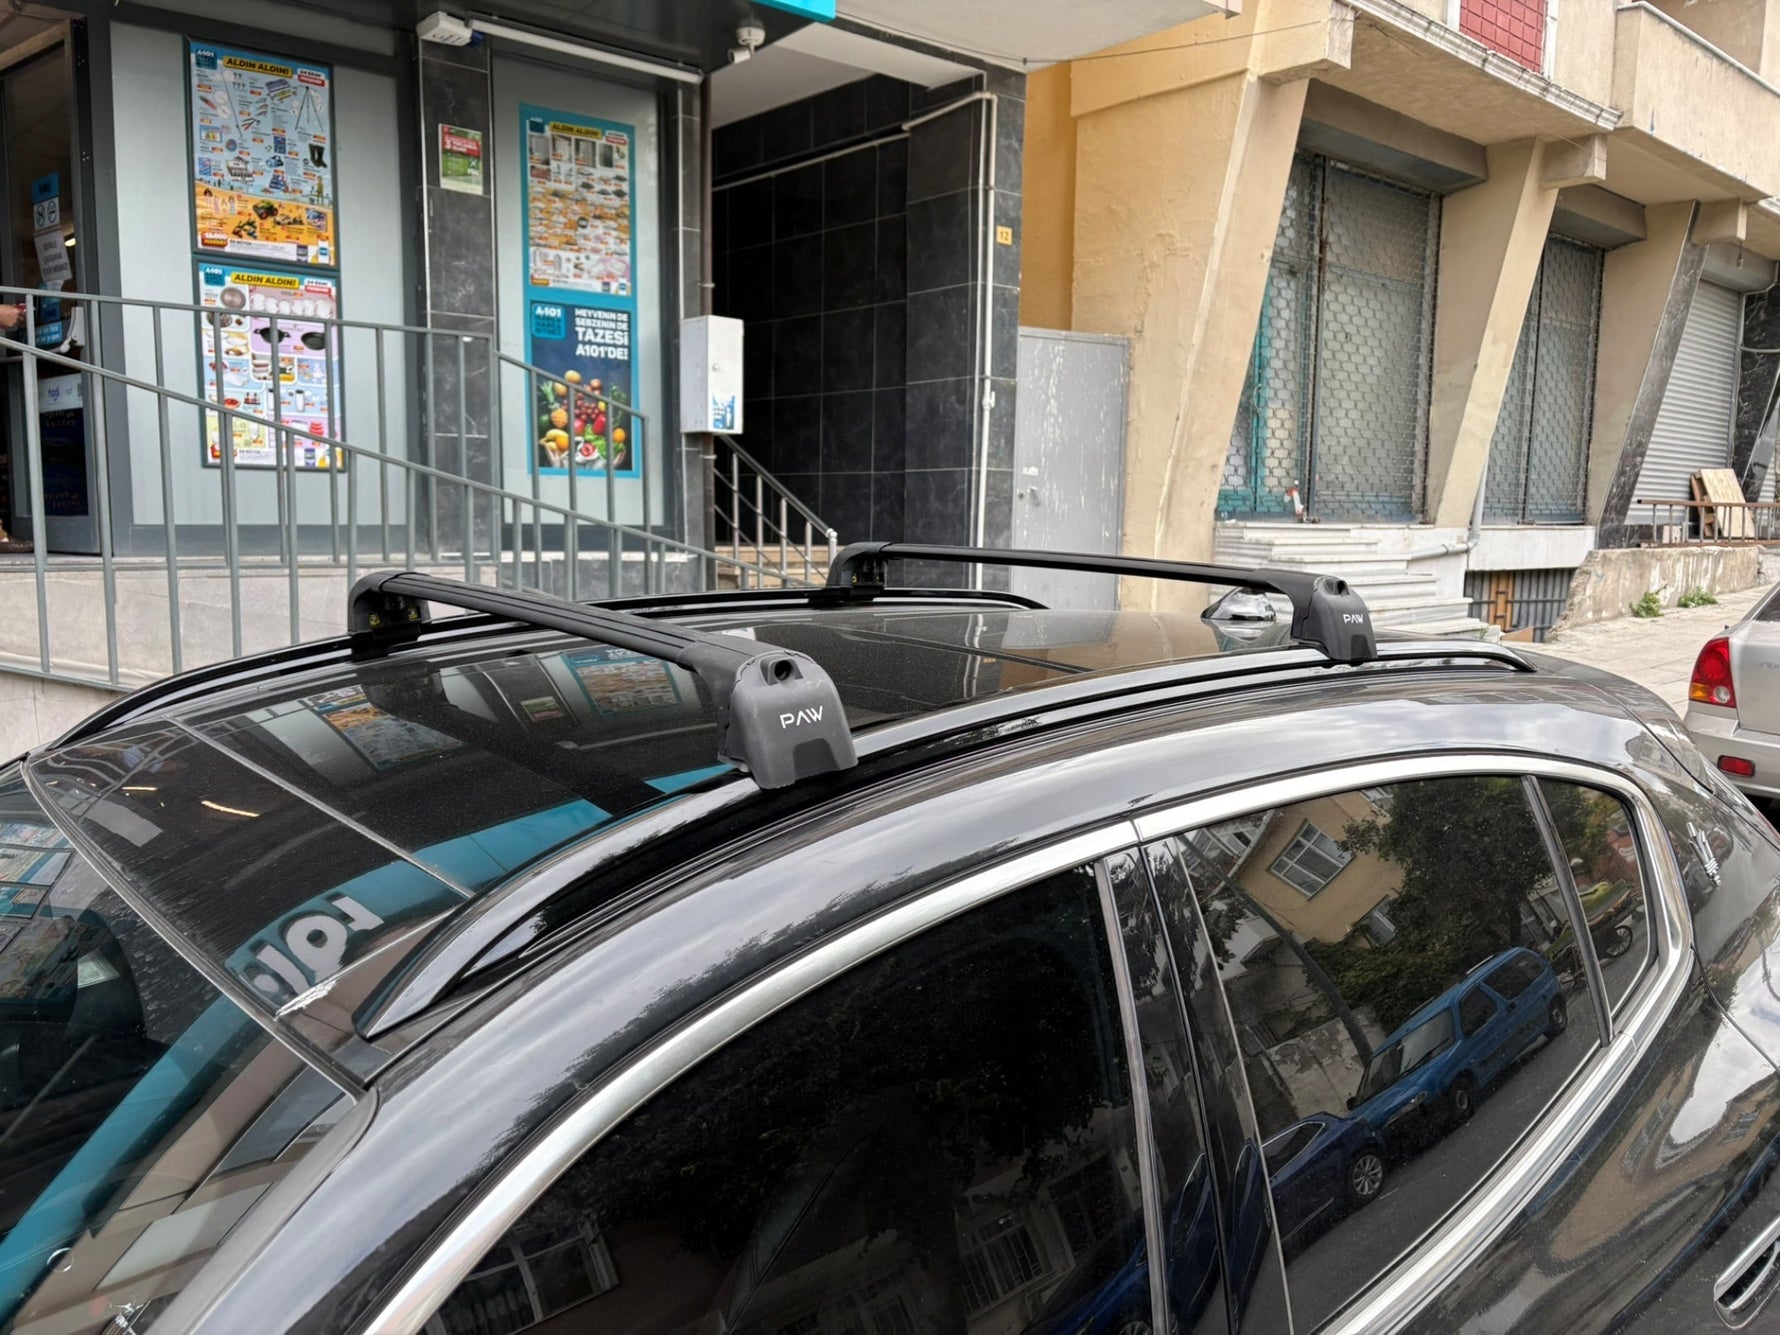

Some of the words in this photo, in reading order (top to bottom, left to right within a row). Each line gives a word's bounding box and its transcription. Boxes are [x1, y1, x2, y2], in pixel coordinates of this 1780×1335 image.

[226, 57, 256, 68] ALDIN
[257, 63, 289, 74] ALDIN!
[234, 273, 263, 283] ALDIN
[265, 277, 296, 287] ALDIN!
[535, 305, 562, 319] A101
[616, 312, 629, 321] DE
[616, 321, 629, 331] DE
[574, 326, 629, 346] TAZESİ
[575, 343, 629, 360] A101'DE!
[1342, 613, 1364, 624] PAW
[779, 705, 823, 729] PAW
